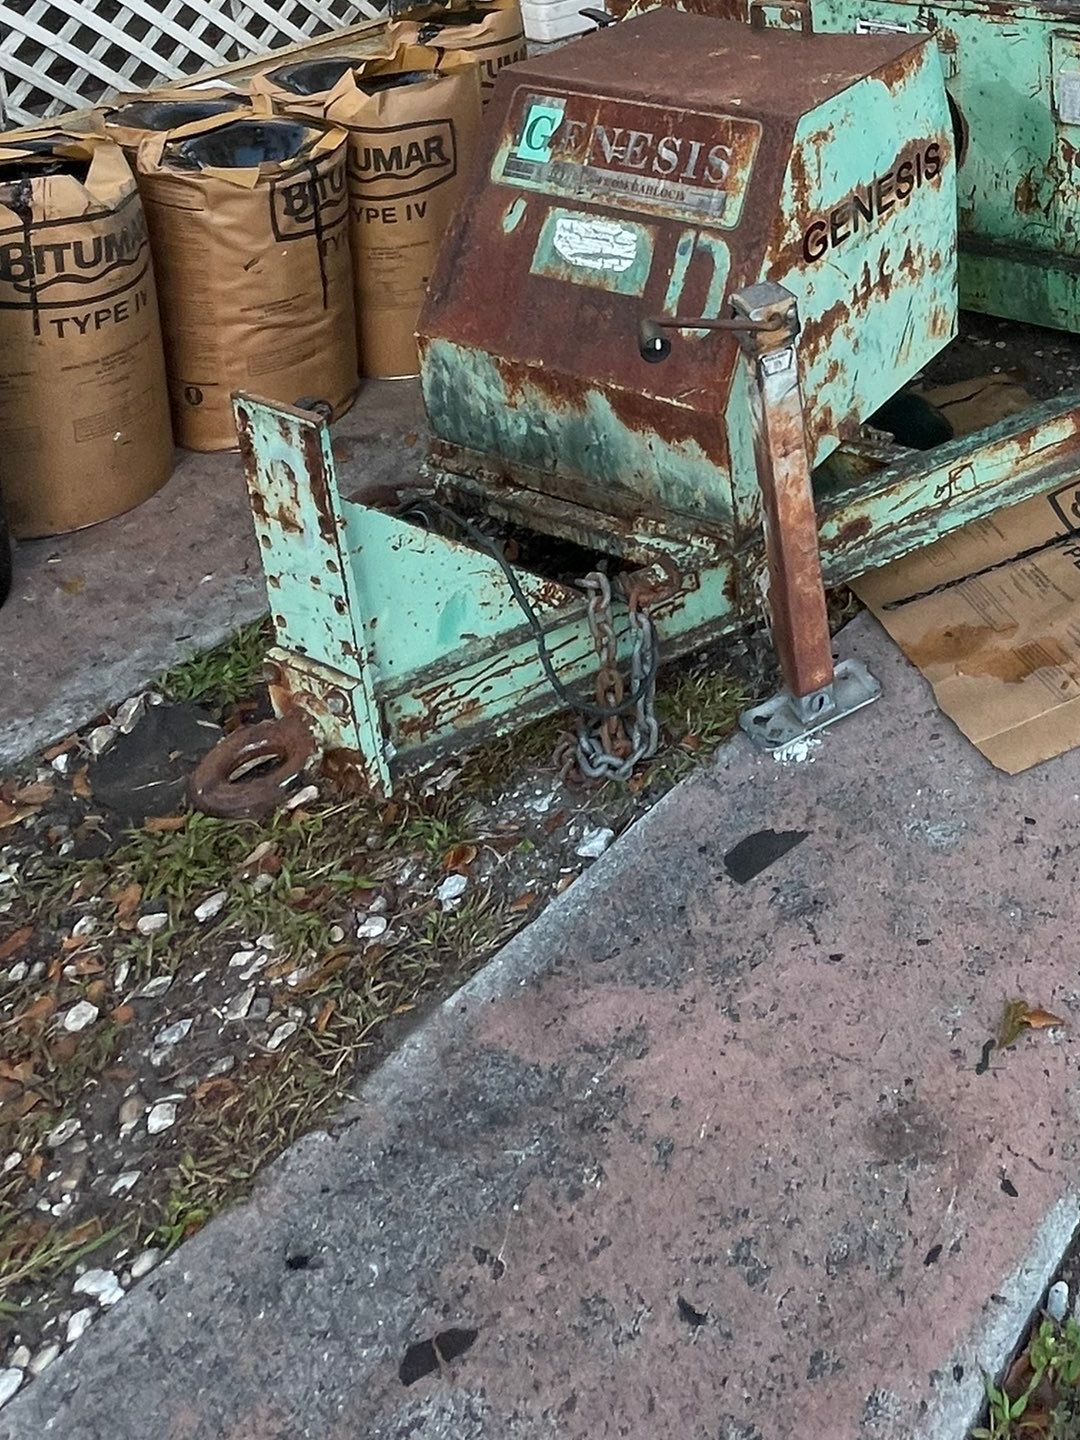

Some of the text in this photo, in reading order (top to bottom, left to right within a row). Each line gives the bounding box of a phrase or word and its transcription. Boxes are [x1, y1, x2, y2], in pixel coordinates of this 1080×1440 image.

[525, 116, 734, 185] GENESIS
[406, 201, 427, 221] IV
[803, 143, 941, 263] GENESIS
[49, 300, 129, 339] TYPE
